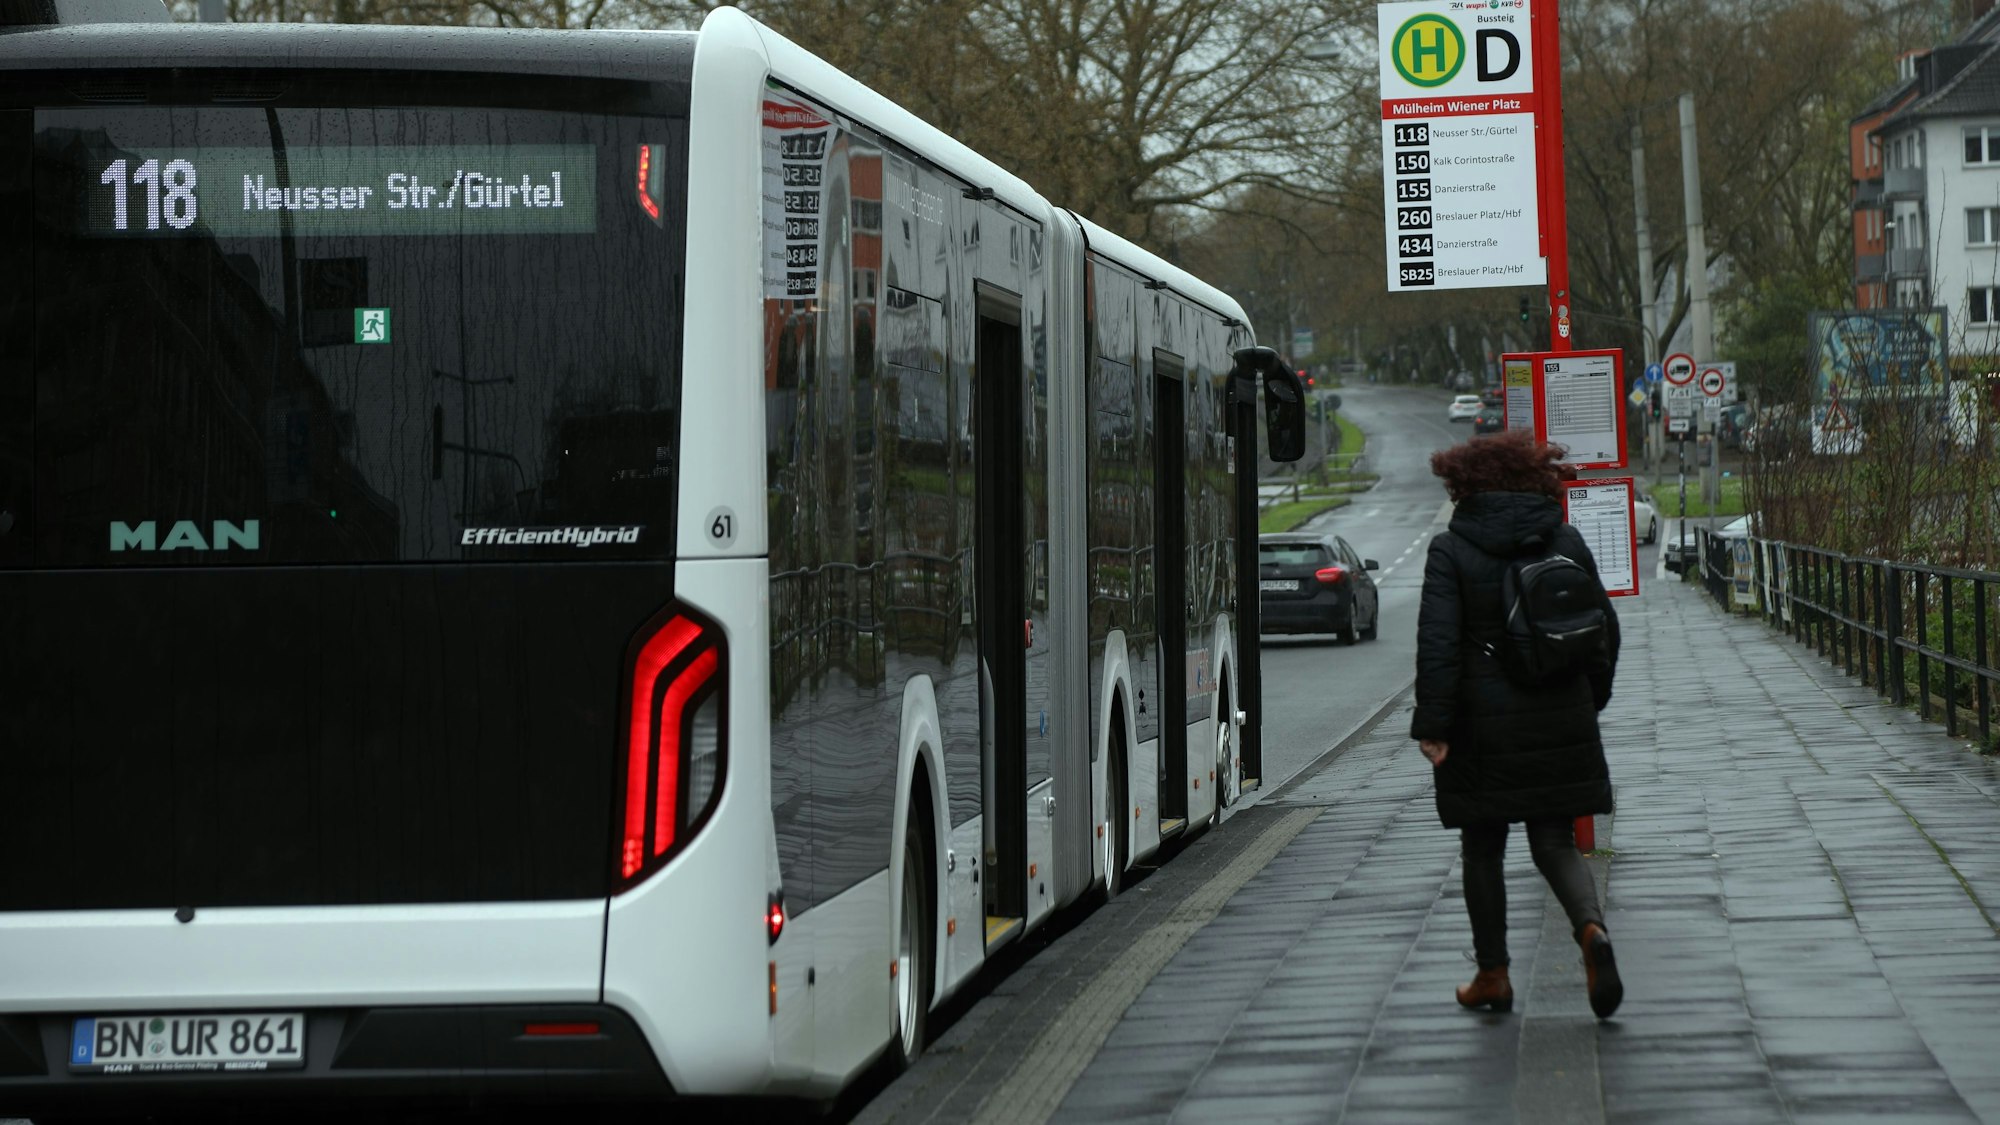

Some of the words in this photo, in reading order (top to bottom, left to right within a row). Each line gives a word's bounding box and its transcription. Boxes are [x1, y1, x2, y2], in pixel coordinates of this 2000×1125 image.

[1465, 0, 1488, 10] wupsi
[1477, 13, 1515, 23] Bussteig
[1411, 28, 1446, 73] H
[1476, 28, 1521, 82] D
[1392, 102, 1445, 115] Mülheim
[1447, 100, 1490, 112] Wiener
[1492, 98, 1521, 110] Platz
[1396, 126, 1428, 143] 118
[1432, 128, 1469, 138] Neusser
[1470, 125, 1518, 136] Str./Gürtel
[1397, 154, 1429, 171] 150
[1433, 157, 1452, 166] Kalk
[1454, 153, 1515, 165] Corintostraße
[101, 158, 197, 230] 118
[243, 174, 373, 210] Neusser
[387, 169, 564, 209] Str./Gürtel
[1398, 182, 1430, 198] 155
[1434, 182, 1496, 194] Danzierstraße
[1399, 210, 1431, 226] 260
[1435, 212, 1478, 221] Breslauer
[1480, 208, 1522, 219] Platz/Hbf
[1400, 237, 1432, 254] 434
[1436, 238, 1498, 249] Danzierstraße
[1400, 268, 1434, 282] SB25
[1437, 267, 1480, 277] Breslauer
[1482, 264, 1524, 275] Platz/Hbf
[1546, 364, 1559, 372] 155
[1571, 490, 1587, 499] SB25
[110, 519, 259, 551] MAN
[711, 515, 731, 539] 61
[460, 526, 641, 548] EfficientHybrid
[95, 1020, 146, 1059] BN
[171, 1018, 220, 1056] UR
[229, 1017, 298, 1055] 861
[78, 1045, 87, 1057] D
